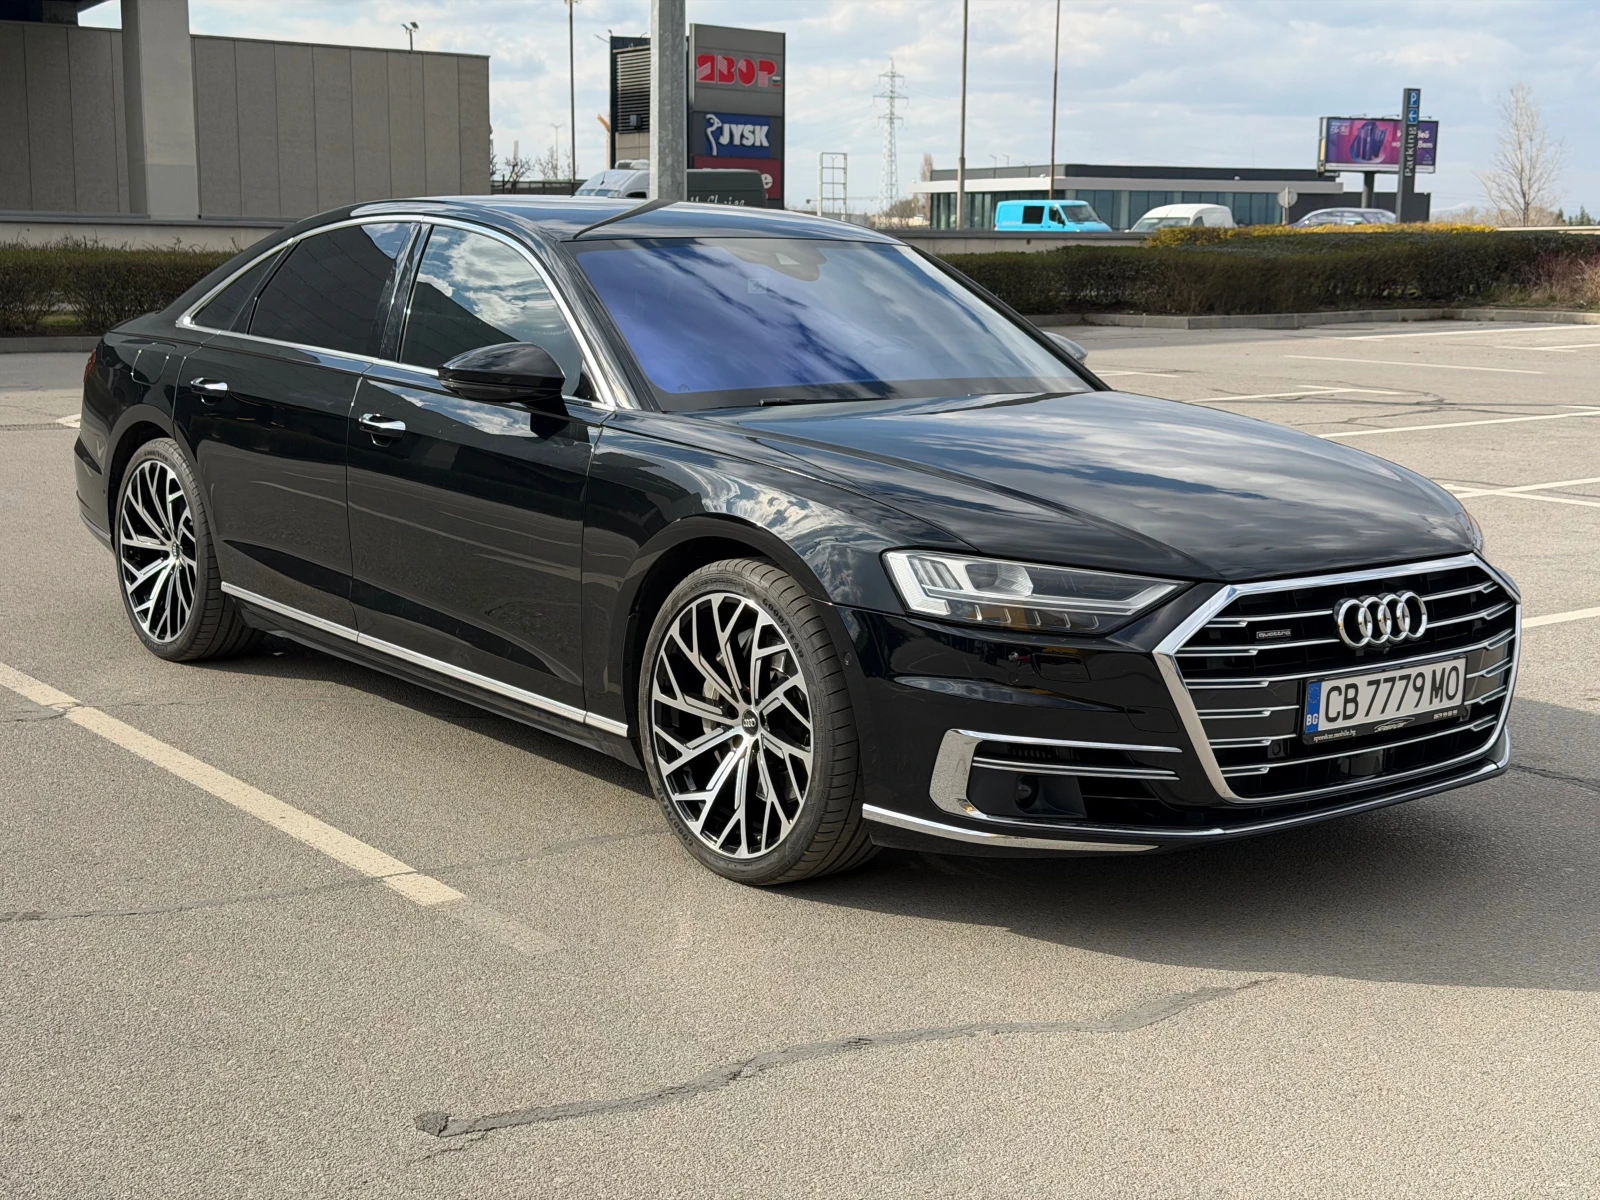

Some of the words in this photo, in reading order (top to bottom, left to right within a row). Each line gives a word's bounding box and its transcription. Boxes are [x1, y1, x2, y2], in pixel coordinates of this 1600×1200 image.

[718, 124, 769, 147] JYSK
[1405, 127, 1417, 176] Parking
[761, 598, 805, 659] GOODYEAR
[1258, 630, 1291, 638] quattro
[1306, 713, 1319, 726] BG
